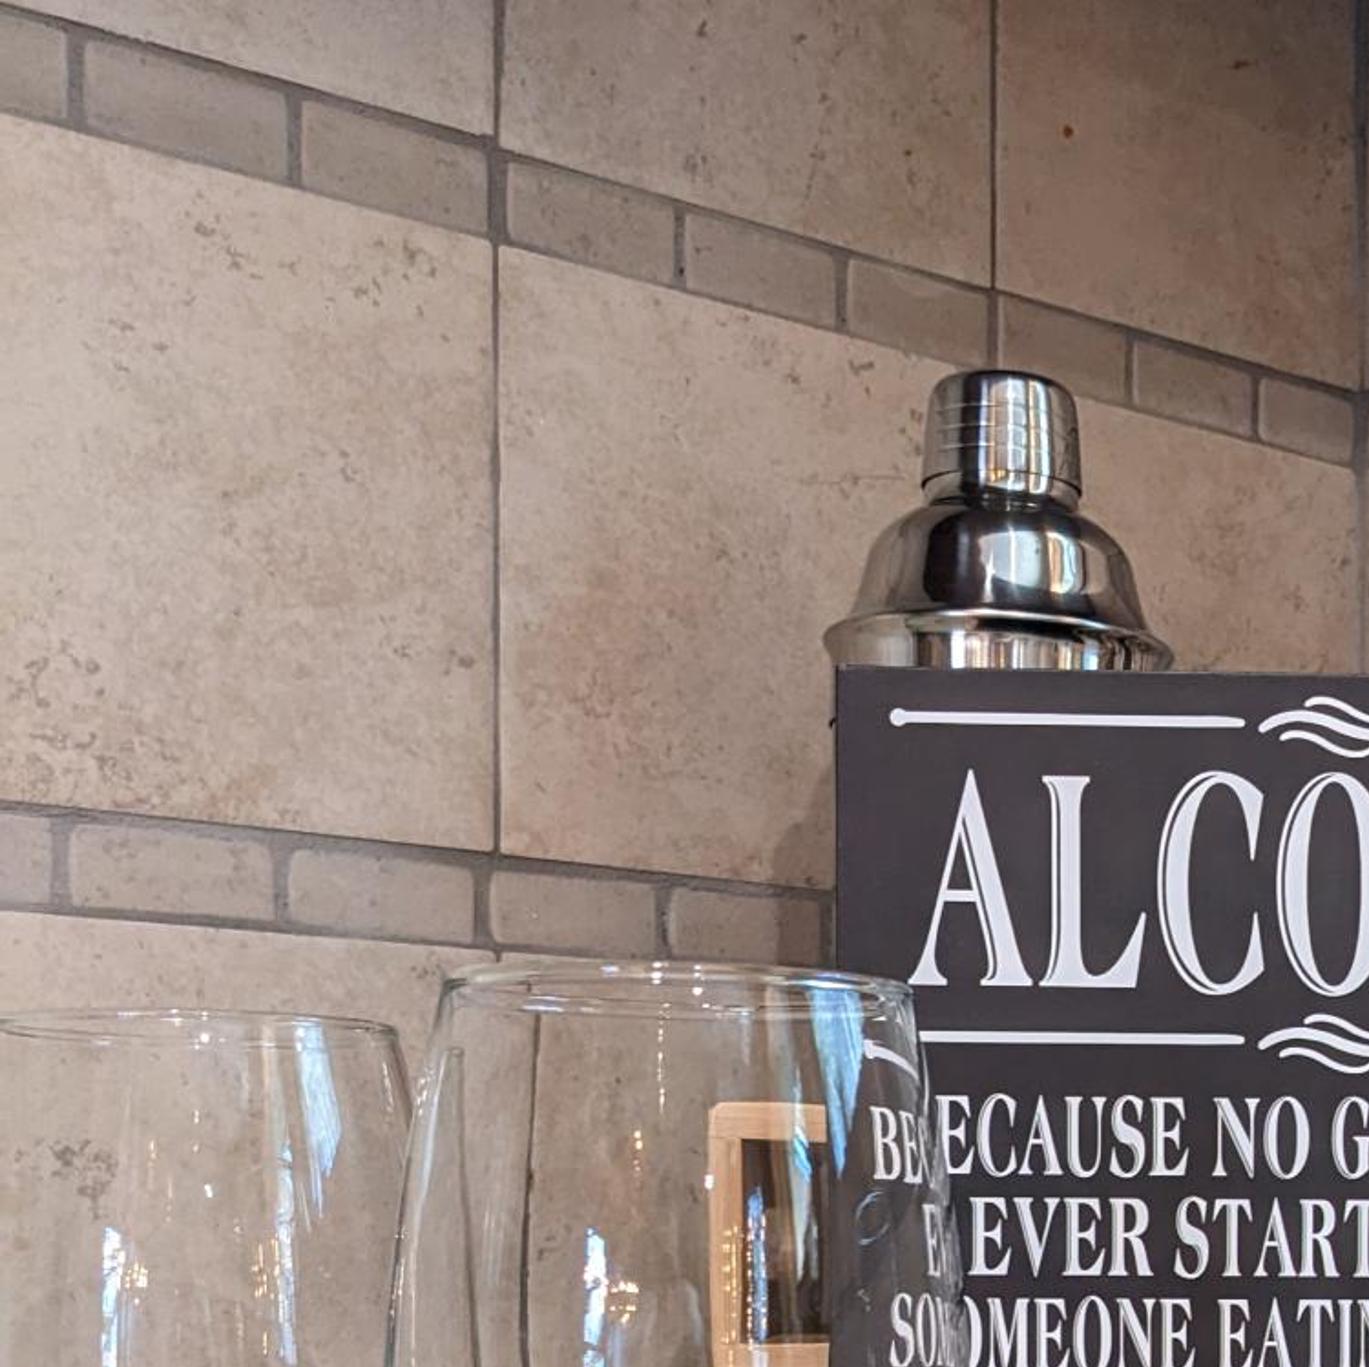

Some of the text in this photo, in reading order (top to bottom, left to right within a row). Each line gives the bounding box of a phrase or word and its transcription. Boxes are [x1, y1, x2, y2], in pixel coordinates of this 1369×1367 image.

[870, 1093, 1189, 1184] BECAUSE
[1211, 1096, 1310, 1180] NO
[966, 1197, 1154, 1279] EVER
